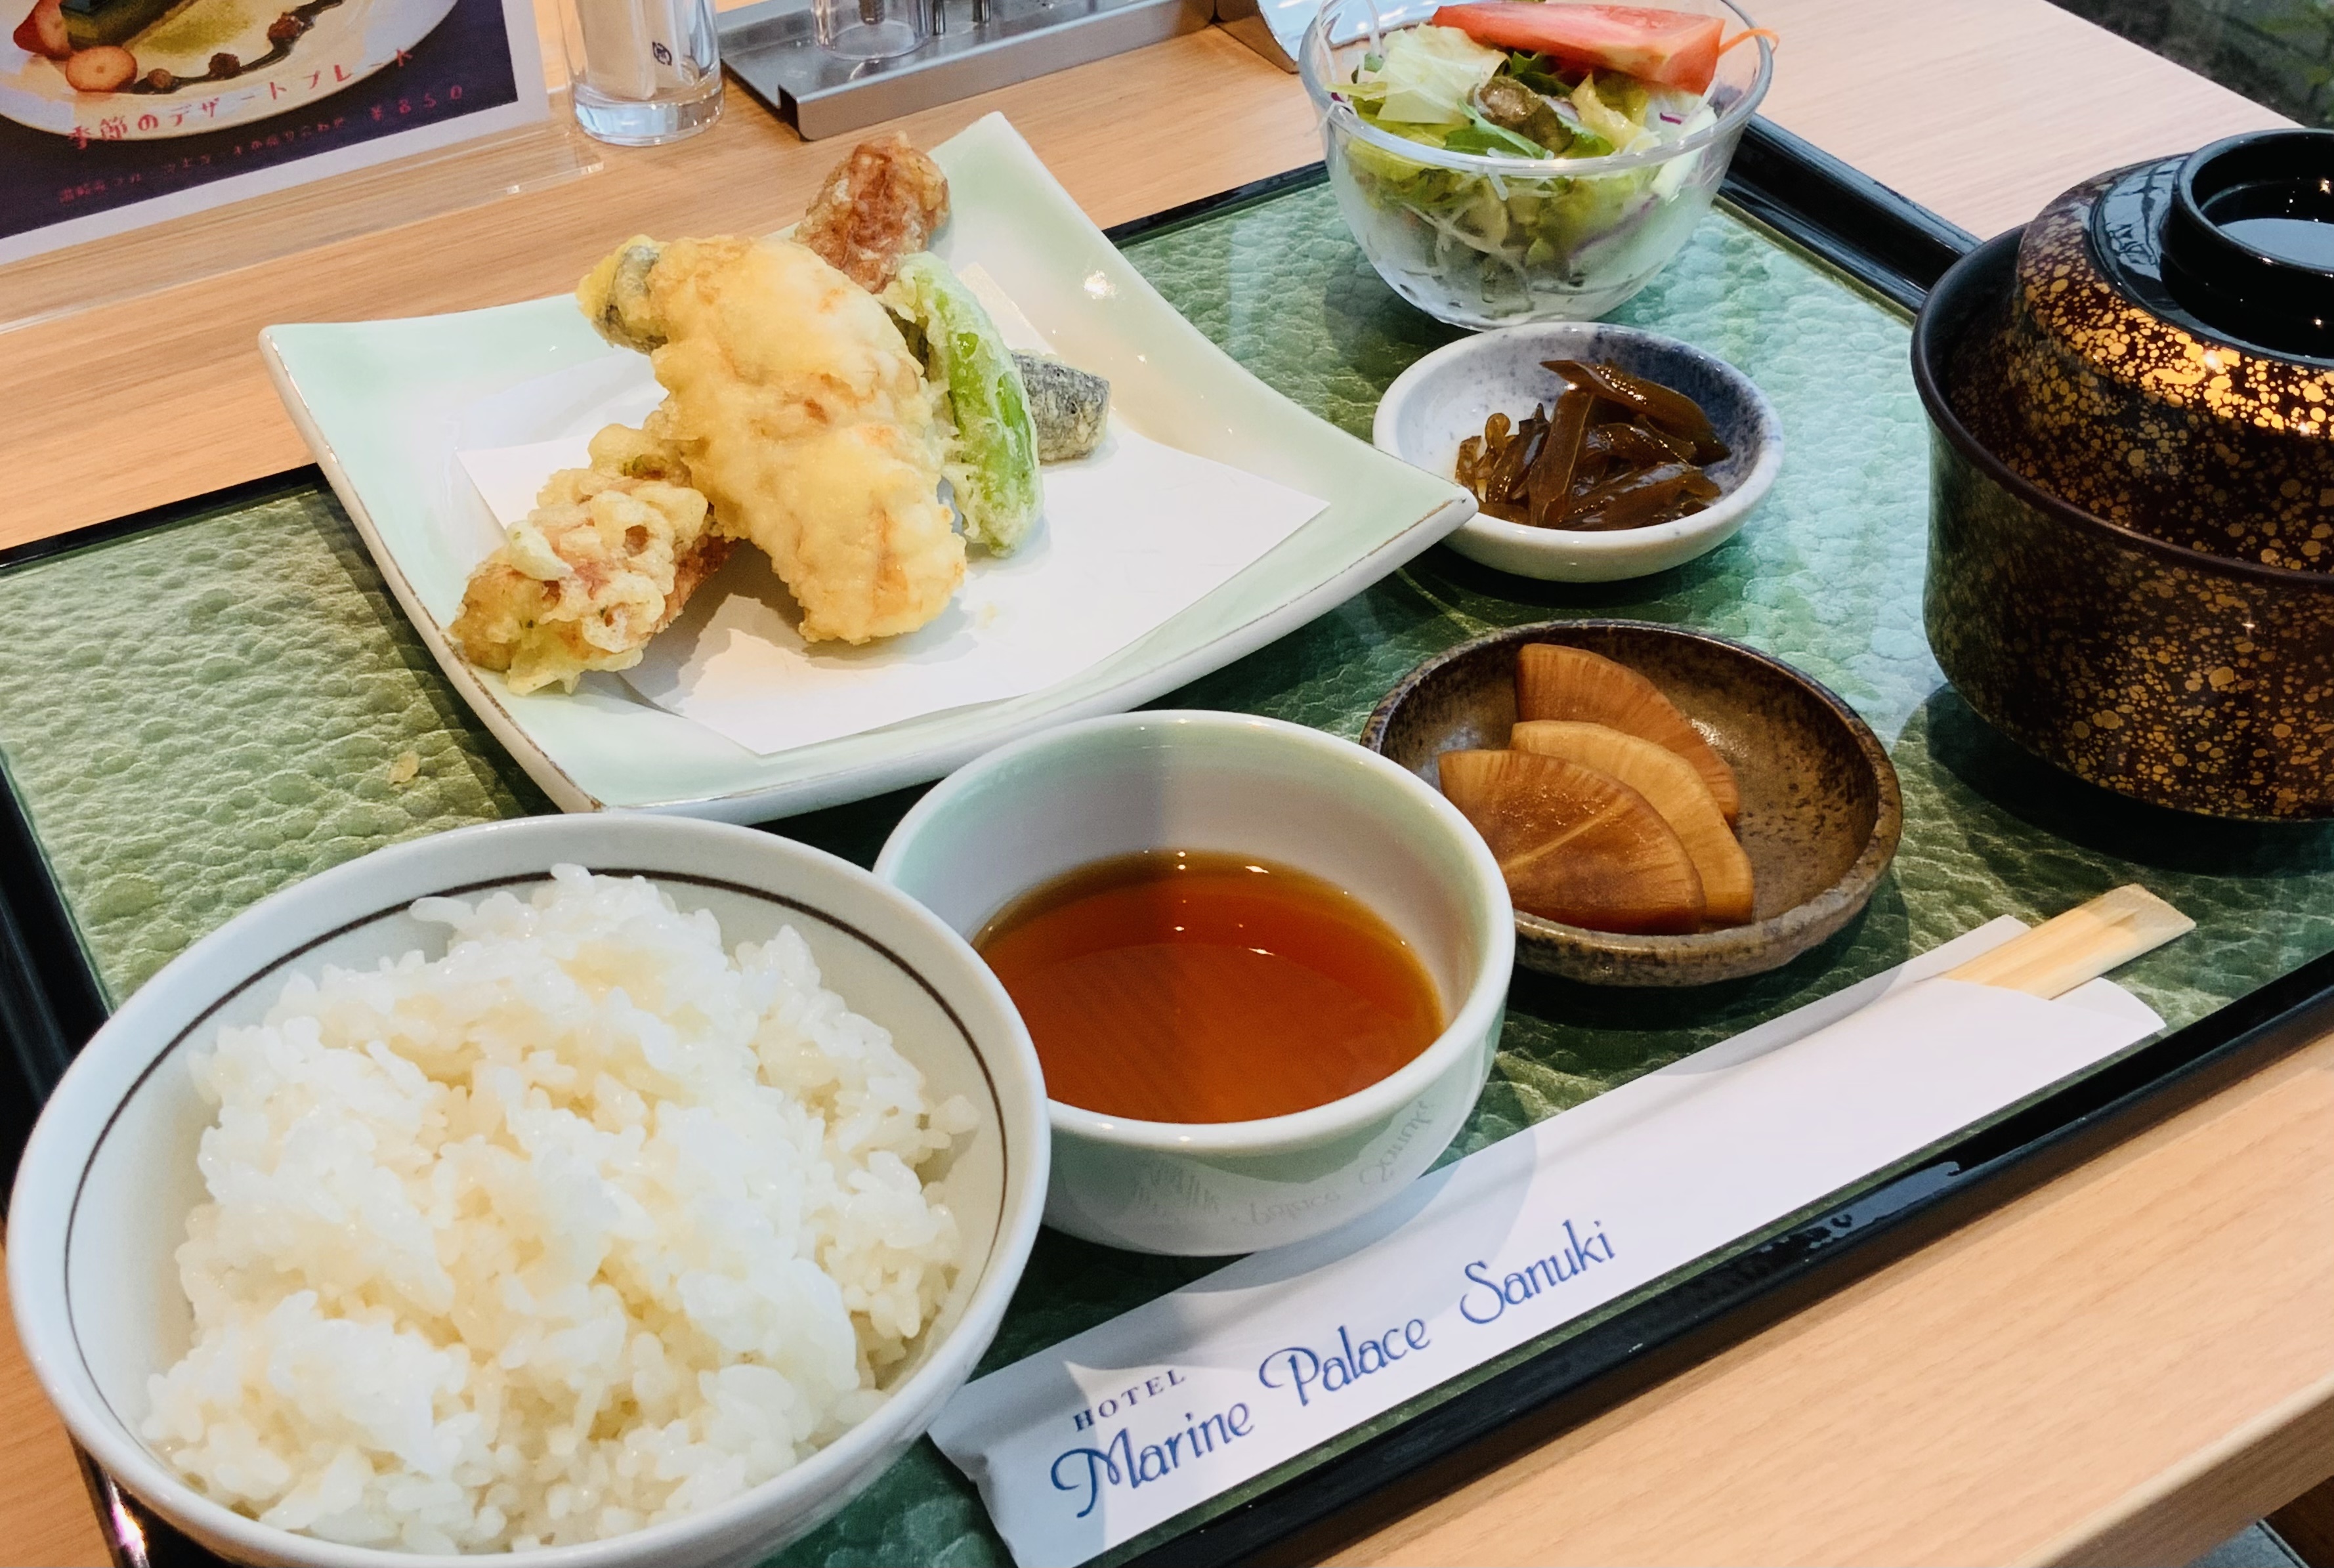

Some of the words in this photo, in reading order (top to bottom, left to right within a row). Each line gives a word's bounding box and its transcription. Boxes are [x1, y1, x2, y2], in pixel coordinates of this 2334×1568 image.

[68, 49, 413, 150] 季節のデザートプレート
[1050, 1402, 1255, 1518] Marine
[1258, 1318, 1432, 1407] Palace
[1460, 1219, 1616, 1324] Sanuki
[1072, 1368, 1186, 1432] HOTEL
